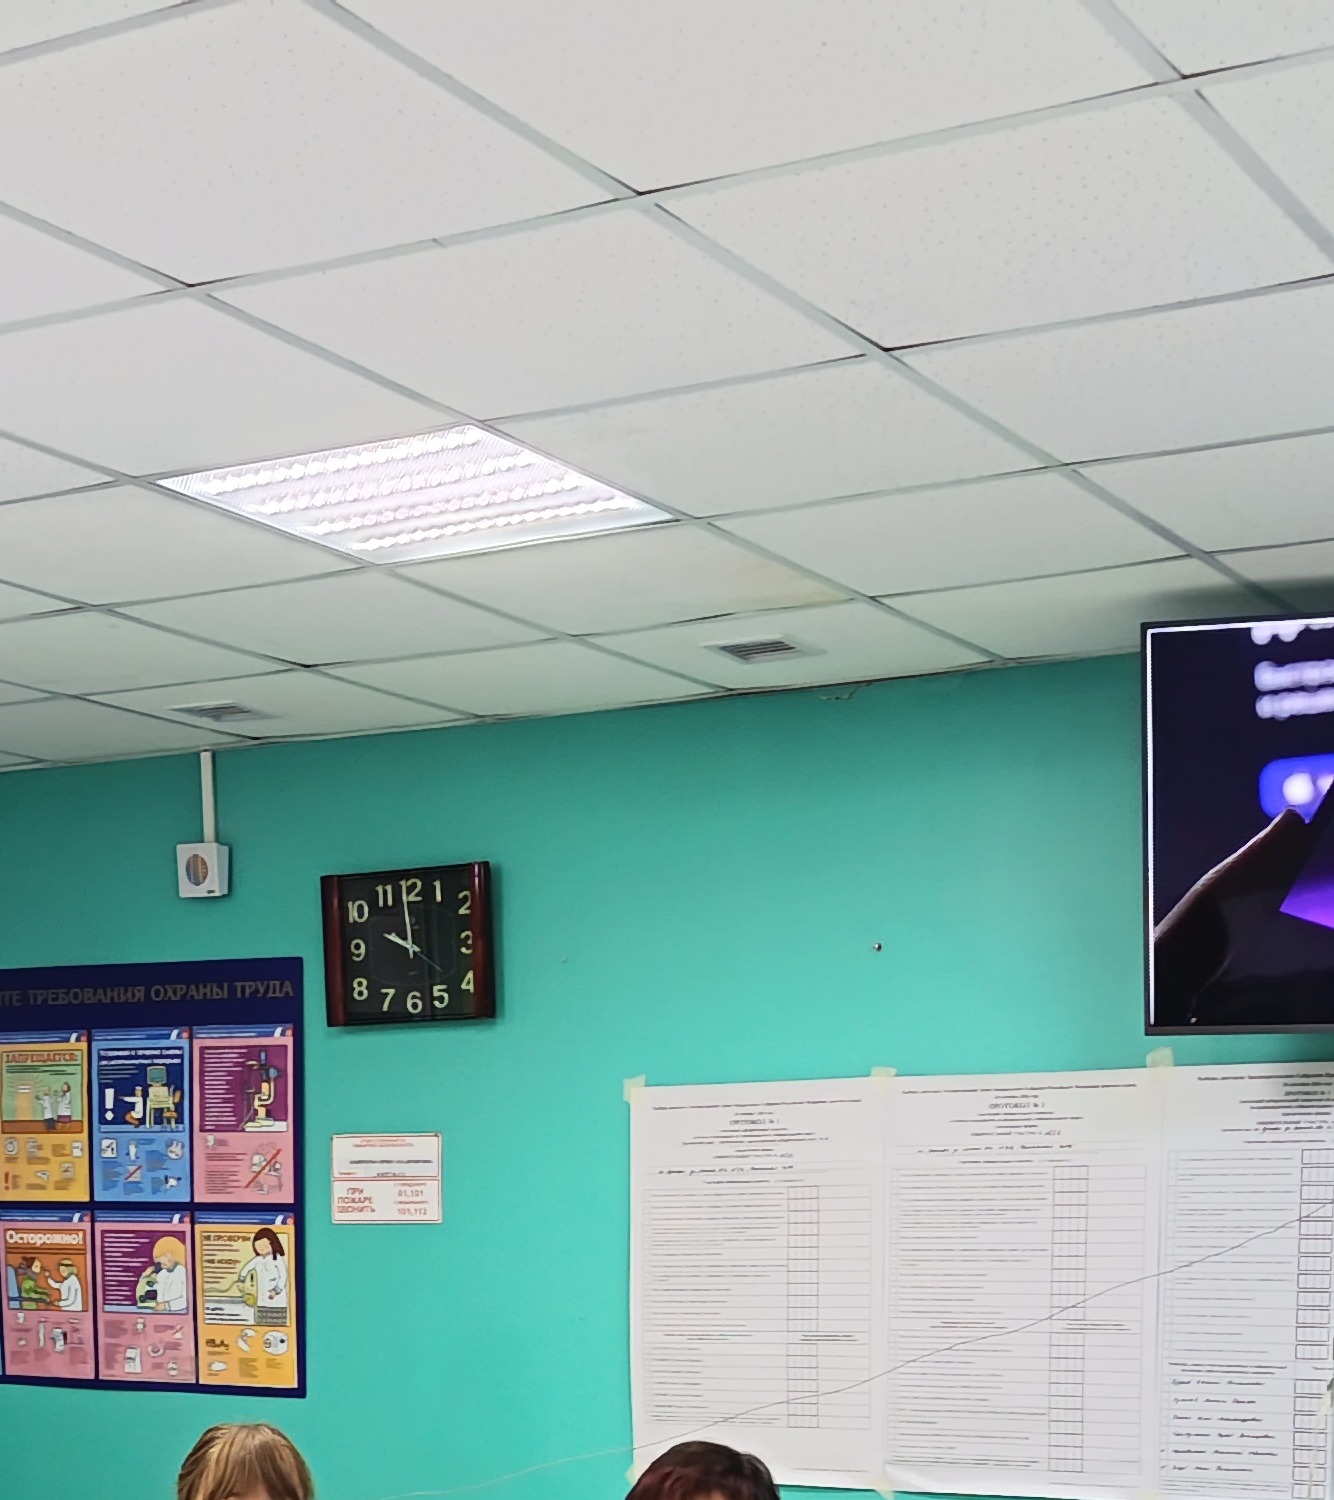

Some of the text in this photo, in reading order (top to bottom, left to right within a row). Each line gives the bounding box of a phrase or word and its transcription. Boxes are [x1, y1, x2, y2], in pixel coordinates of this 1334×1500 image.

[375, 884, 393, 908] 11
[433, 879, 442, 902] 1
[347, 900, 369, 923] 10
[457, 890, 472, 915] 2
[350, 939, 366, 961] 9
[459, 931, 473, 955] 3
[26, 985, 145, 1006] ТРЕБОВАНИЯ
[150, 981, 229, 1002] ОХРАНЫ
[233, 980, 294, 999] ТРУДА
[352, 978, 368, 1001] 8
[461, 970, 474, 993] 4
[380, 988, 396, 1012] 7
[406, 991, 423, 1014] 6
[432, 985, 449, 1008] 5
[6, 1230, 84, 1246] Осторожно!
